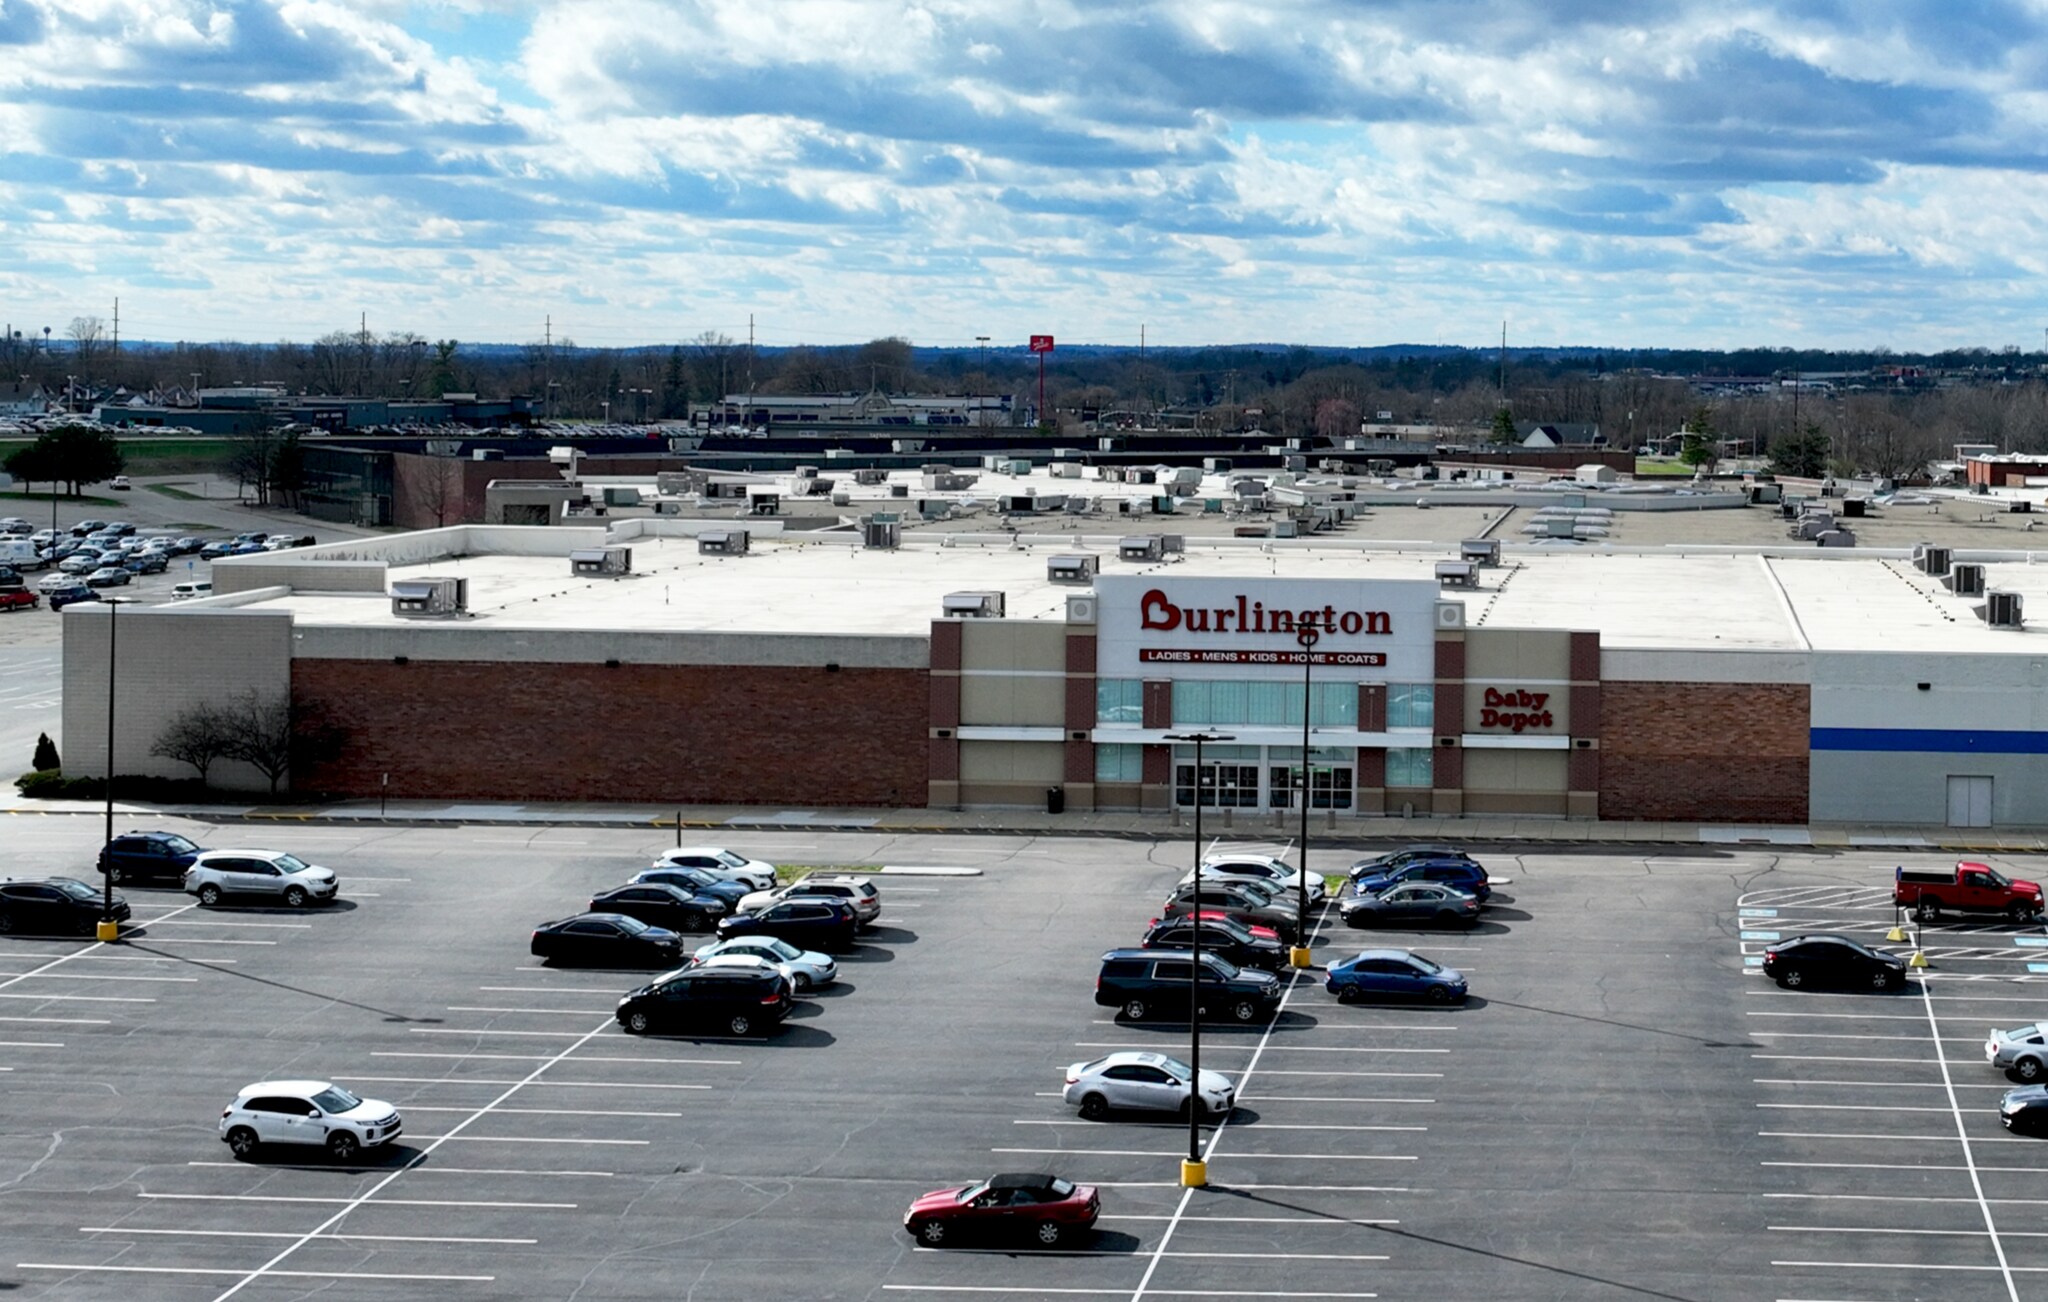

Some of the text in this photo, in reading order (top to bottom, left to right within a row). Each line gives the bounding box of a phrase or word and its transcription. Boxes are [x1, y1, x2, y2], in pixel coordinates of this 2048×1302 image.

[1141, 589, 1393, 646] Burlington
[1148, 651, 1378, 664] LADIES MENS KIDS HOME COATS
[1484, 687, 1549, 711] Baby
[1480, 709, 1553, 732] Depot
